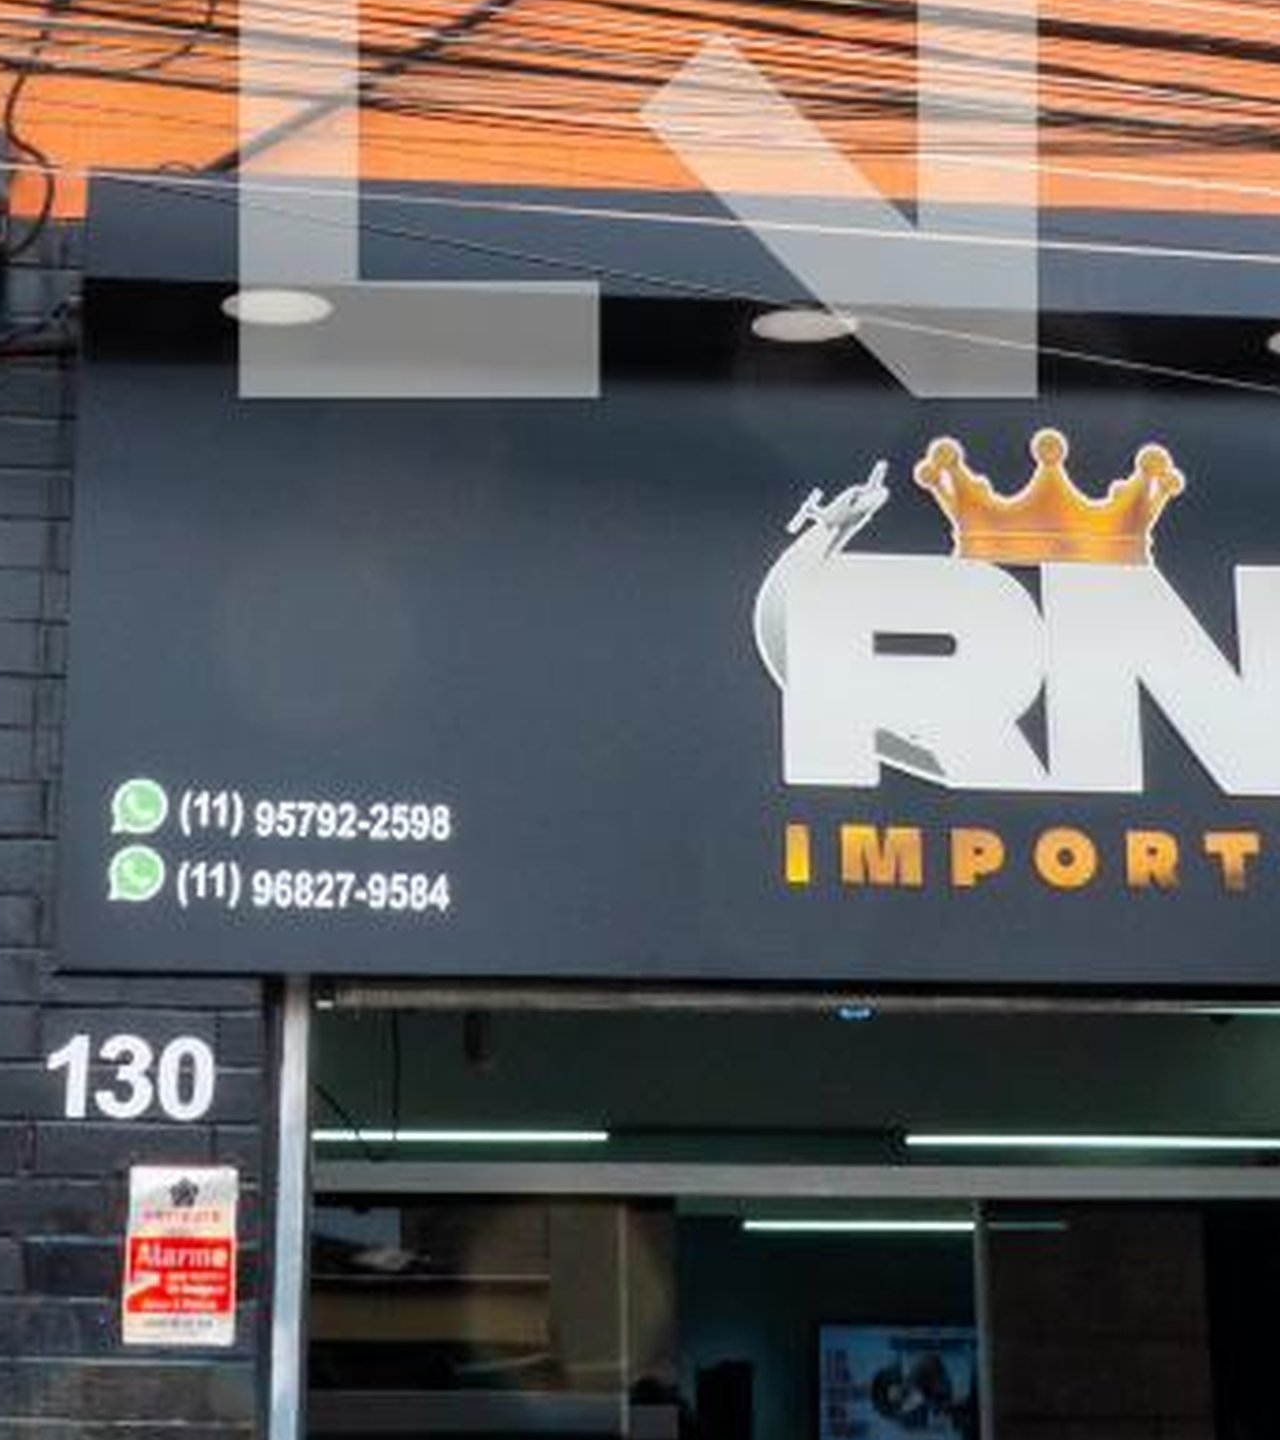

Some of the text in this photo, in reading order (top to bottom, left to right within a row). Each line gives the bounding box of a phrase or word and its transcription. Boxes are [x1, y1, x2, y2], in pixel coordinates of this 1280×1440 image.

[180, 789, 451, 841] (11) 95792-2598
[177, 860, 450, 911] (11) 96827-9584
[46, 1034, 215, 1121] 130
